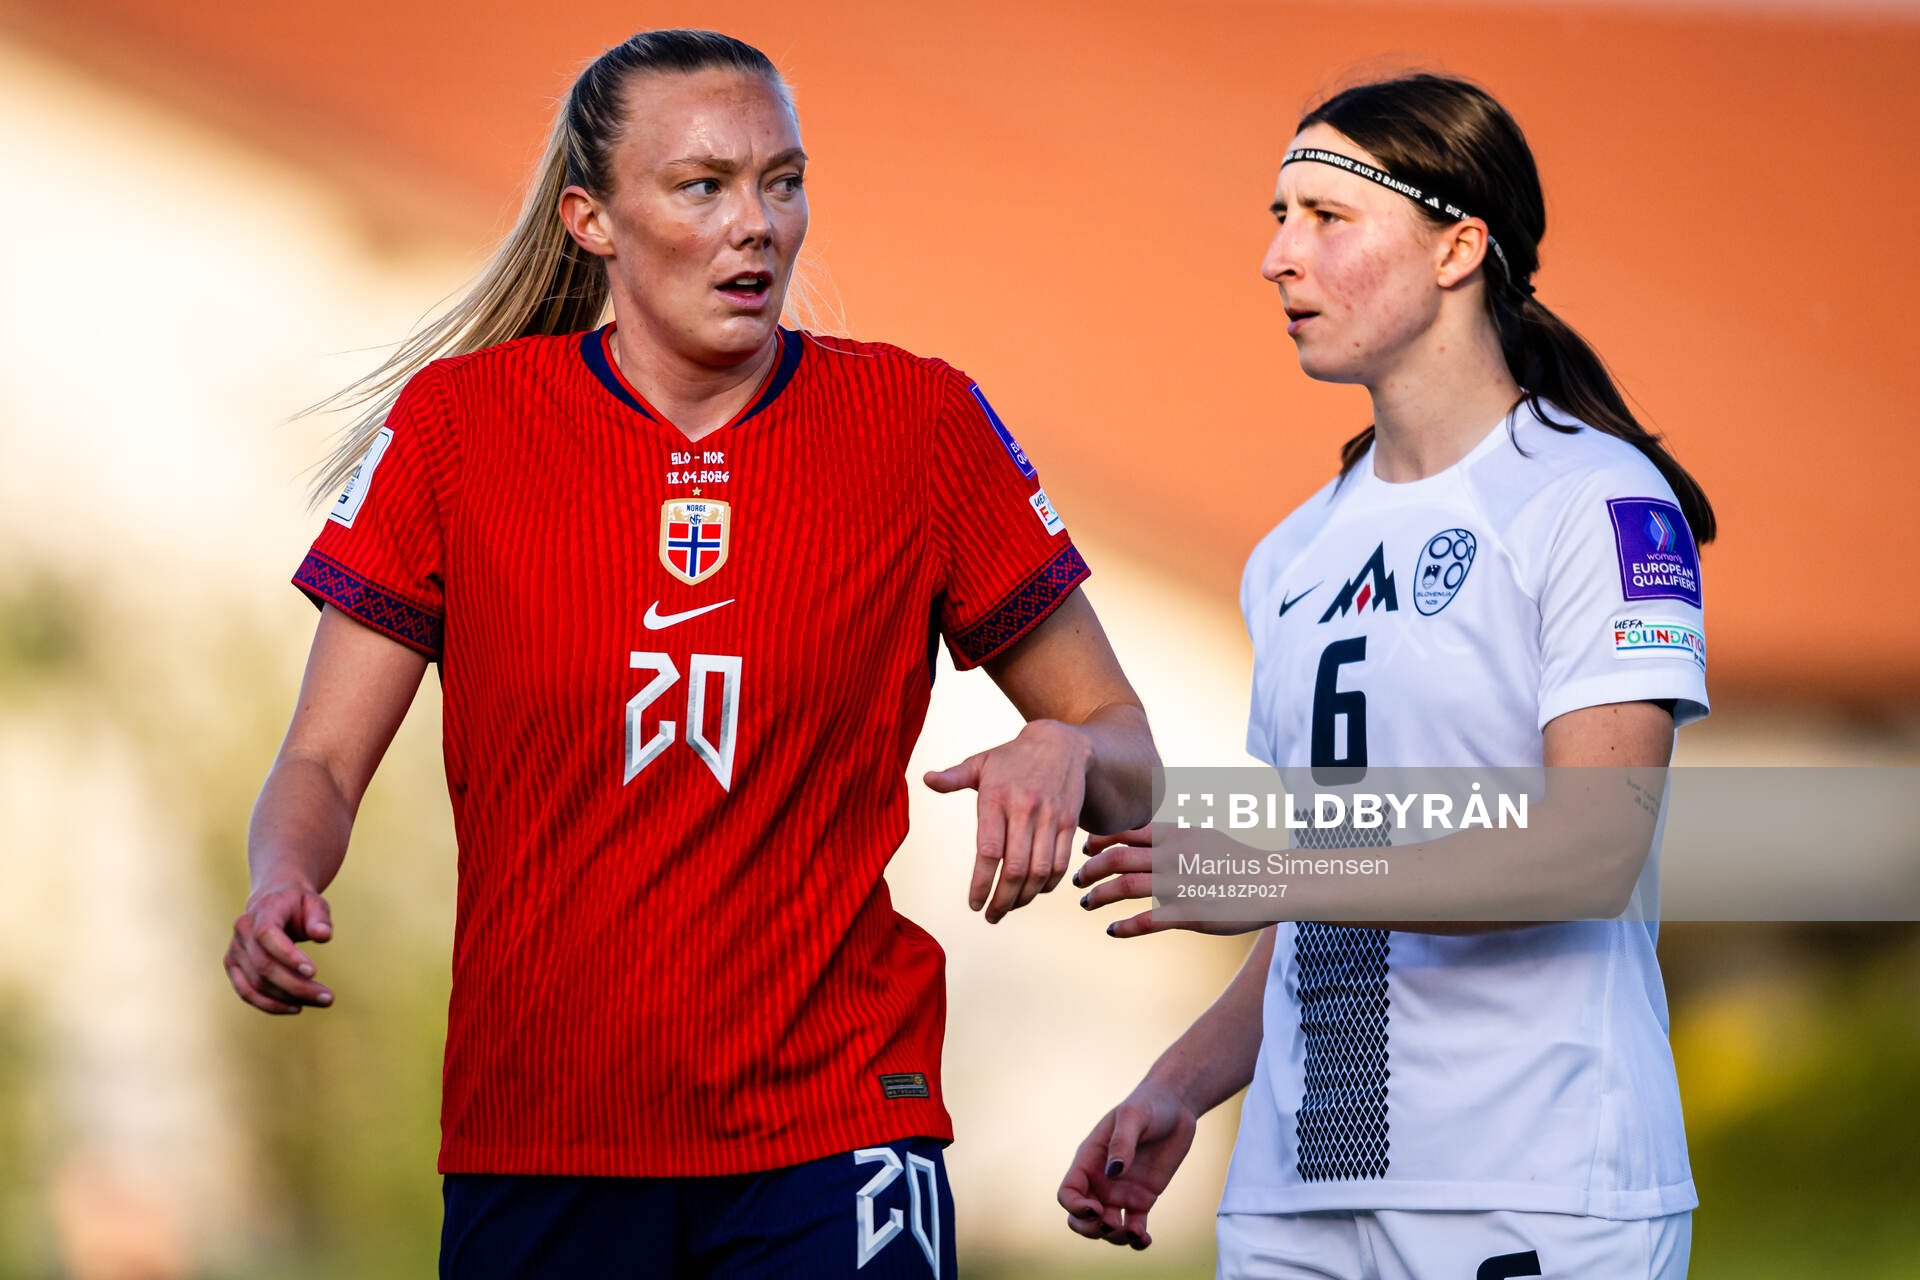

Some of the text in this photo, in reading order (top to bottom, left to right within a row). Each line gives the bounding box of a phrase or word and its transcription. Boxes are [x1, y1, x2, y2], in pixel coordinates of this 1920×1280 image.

[1305, 150, 1315, 159] LA
[1316, 151, 1354, 170] MARQUE
[1353, 164, 1375, 179] AUX
[1375, 172, 1383, 182] 3
[1382, 177, 1422, 199] BANDES
[1444, 203, 1462, 218] DIE
[671, 451, 691, 465] SLO
[703, 451, 725, 465] NOR
[666, 470, 730, 485] 18.04.2026
[686, 504, 707, 512] NORGE
[1646, 552, 1683, 564] women's
[1632, 562, 1694, 580] EUROPEAN
[1632, 574, 1697, 592] QUALIFIERS
[1614, 618, 1644, 629] UEFA
[1311, 636, 1368, 787] 6
[623, 651, 743, 793] 20
[853, 1146, 940, 1280] 20
